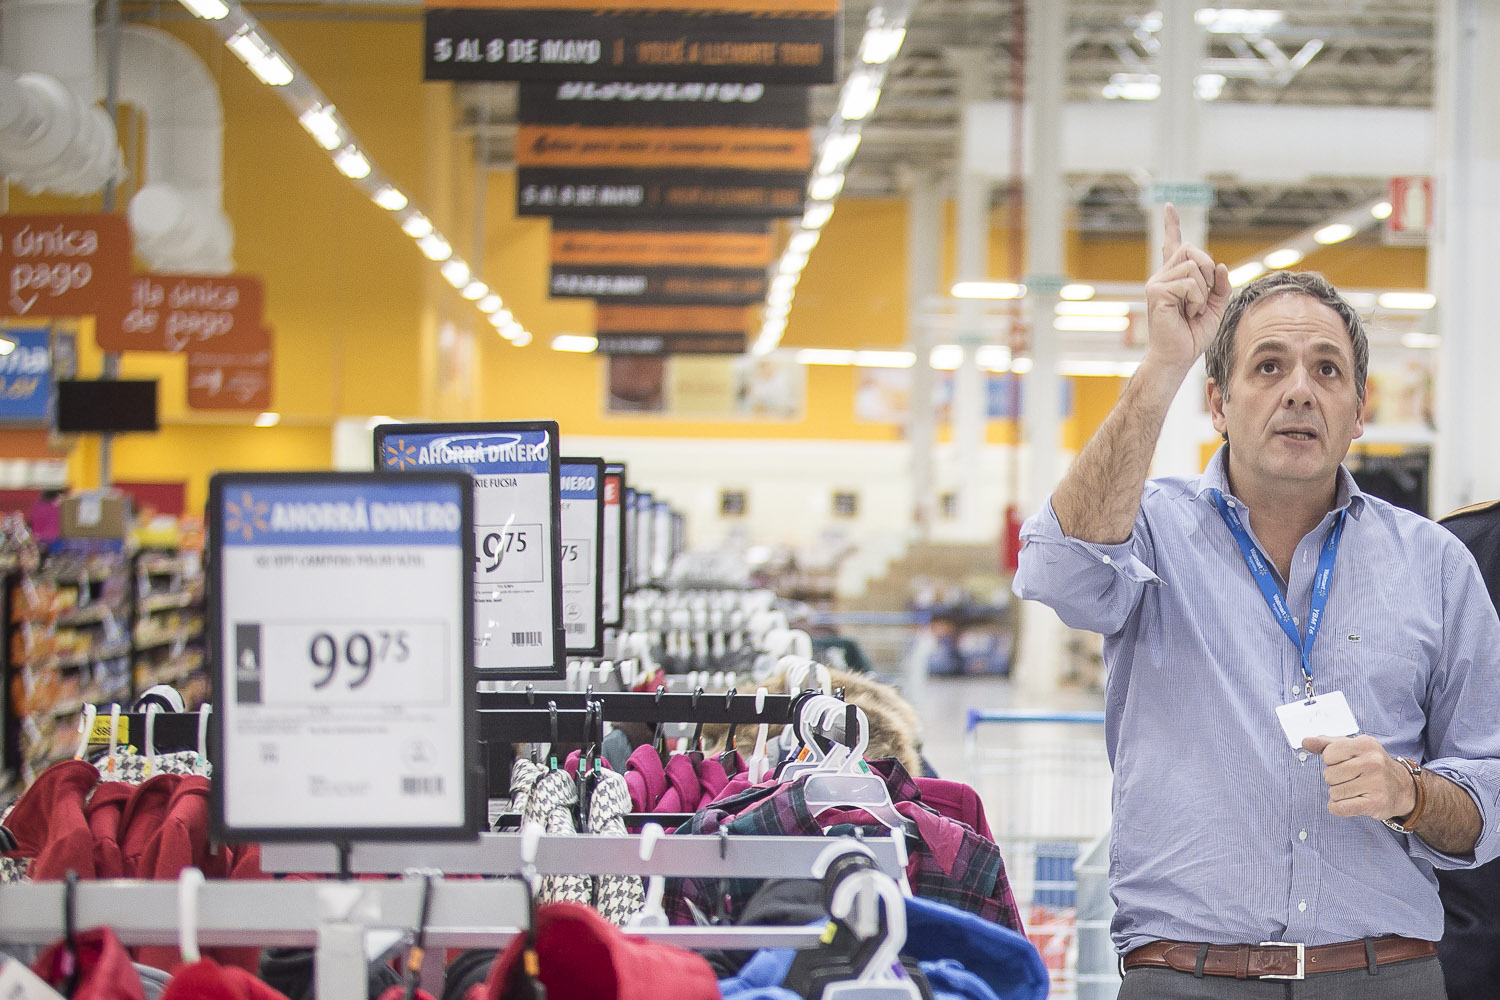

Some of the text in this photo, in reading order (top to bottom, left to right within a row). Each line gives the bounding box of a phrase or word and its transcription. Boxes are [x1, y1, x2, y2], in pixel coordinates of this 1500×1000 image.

[12, 224, 98, 257] única
[8, 262, 93, 313] pago
[487, 443, 549, 463] DINERO
[271, 497, 462, 532] AHORRÁ DINERO
[311, 632, 373, 690] 99
